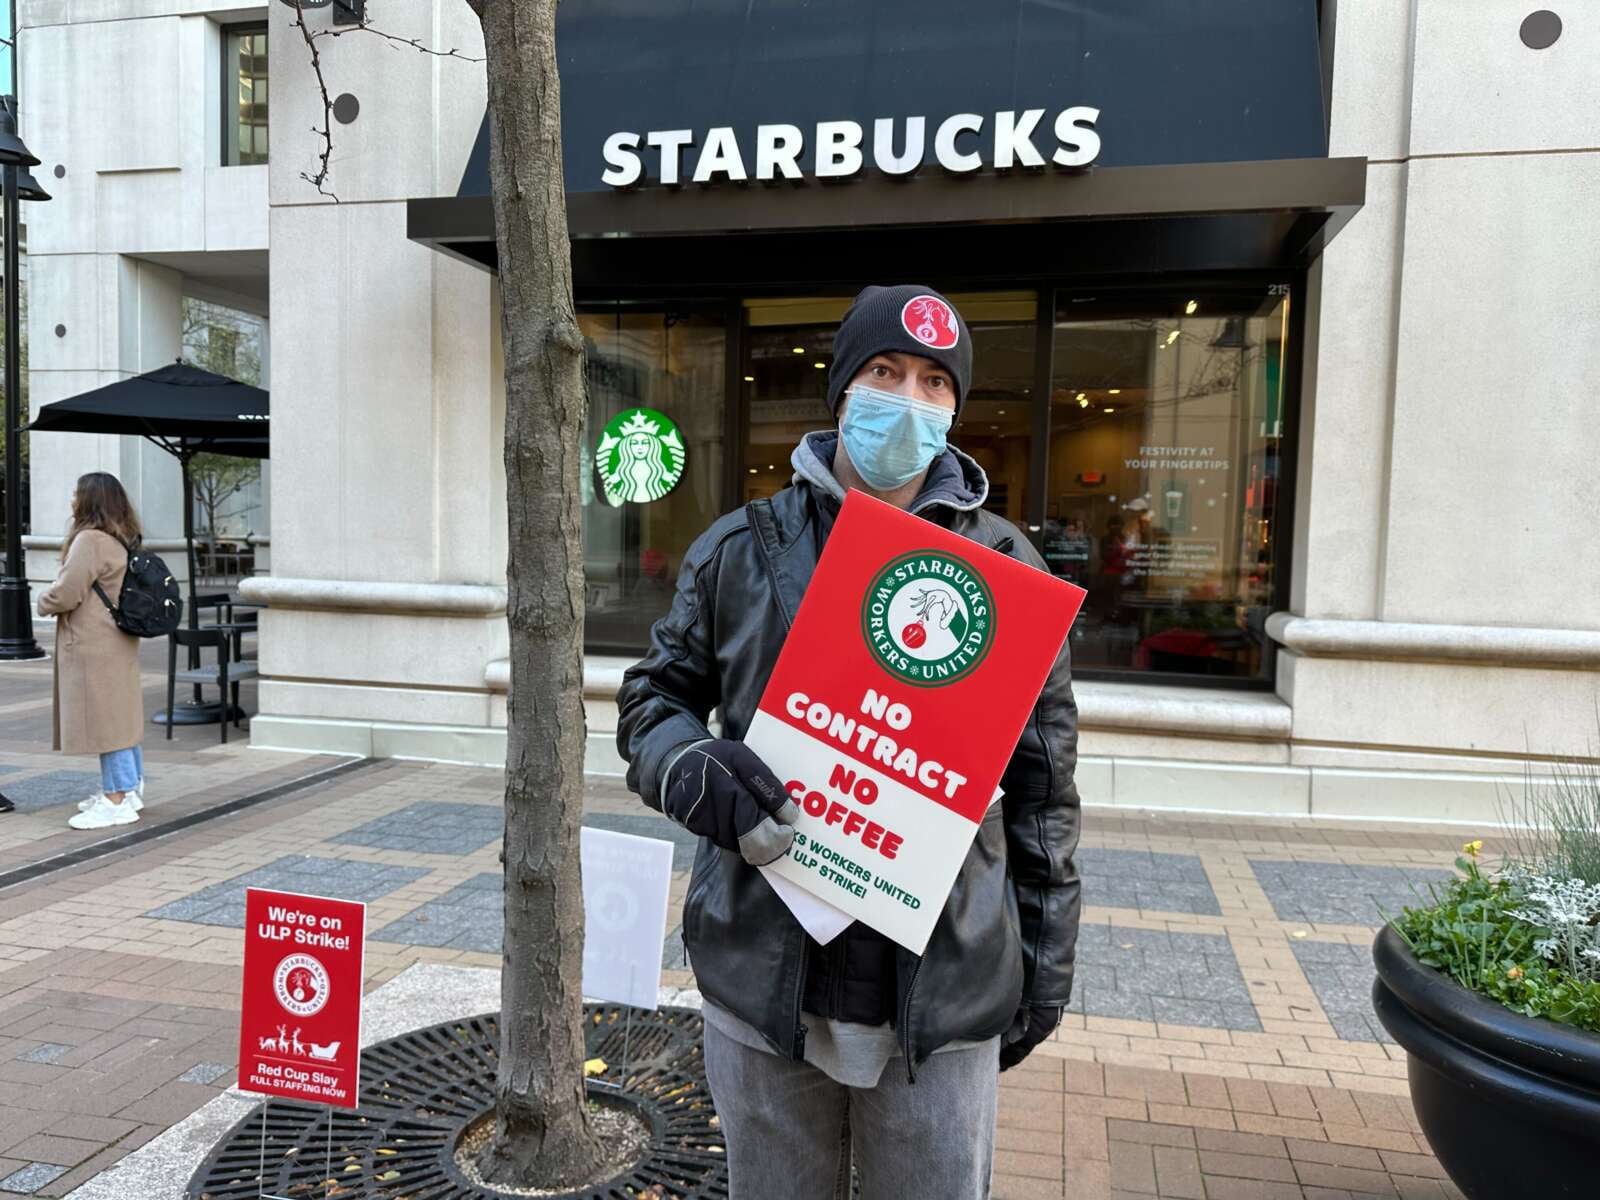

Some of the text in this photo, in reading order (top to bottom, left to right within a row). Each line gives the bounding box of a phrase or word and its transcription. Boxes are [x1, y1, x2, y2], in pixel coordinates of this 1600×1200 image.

[601, 106, 1101, 187] STARBUCKS
[1125, 460, 1230, 470] YOUR FINGERTIPS
[1140, 447, 1215, 456] FESTIVITY AT
[894, 560, 987, 617] STARBUCKS
[871, 587, 909, 671] WORKERS
[922, 631, 982, 679] UNITED
[860, 688, 912, 731] NO
[786, 692, 967, 799] CONTRACT
[829, 763, 879, 805] NO
[784, 780, 904, 860] COFFEE
[793, 851, 868, 899] ULP STRIKE!
[810, 839, 921, 910] WORKERS UNITED
[258, 923, 350, 950] ULP Strike!
[268, 906, 342, 930] We're on
[250, 1075, 346, 1098] FULL STAFFING NOW
[257, 1063, 338, 1088] Red Cup Slay
